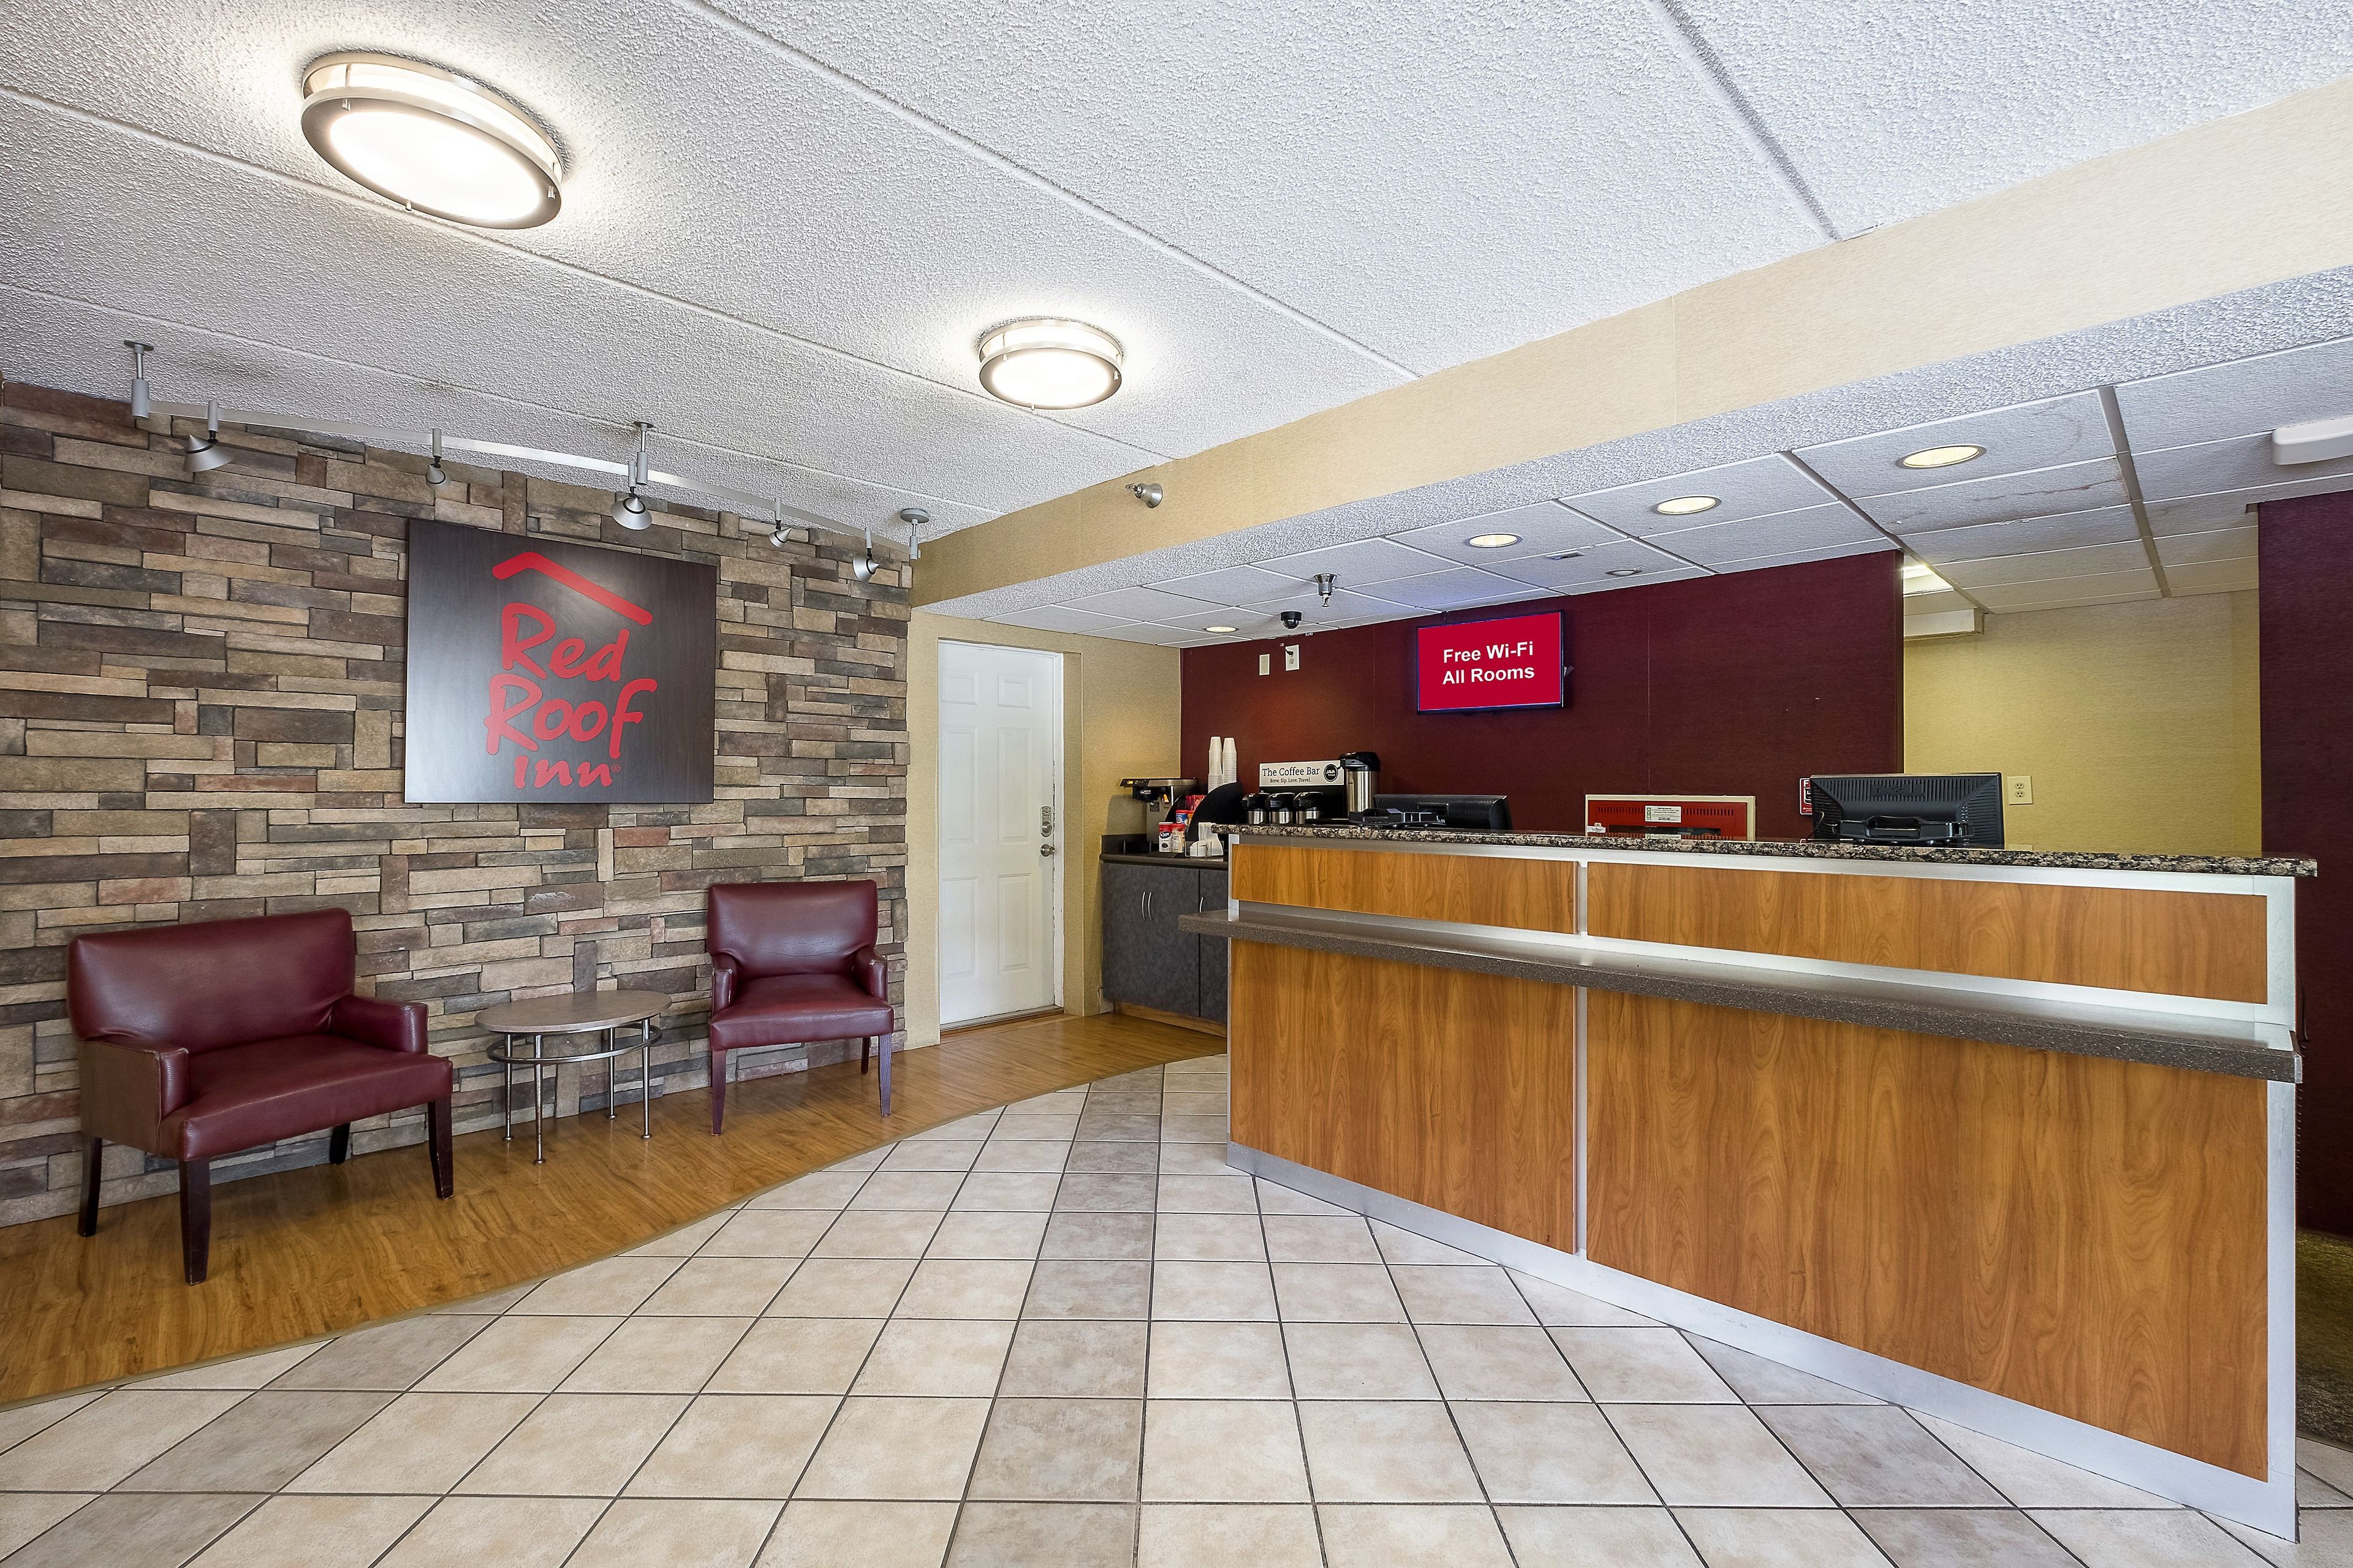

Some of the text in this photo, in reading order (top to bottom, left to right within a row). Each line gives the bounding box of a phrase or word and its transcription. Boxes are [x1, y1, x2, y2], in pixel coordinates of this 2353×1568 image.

[502, 602, 630, 681] Red
[1443, 641, 1533, 663] Free Wi-Fi
[1442, 667, 1535, 684] All Rooms
[483, 673, 657, 759] Roof
[1262, 767, 1320, 776] The Coffee Bar
